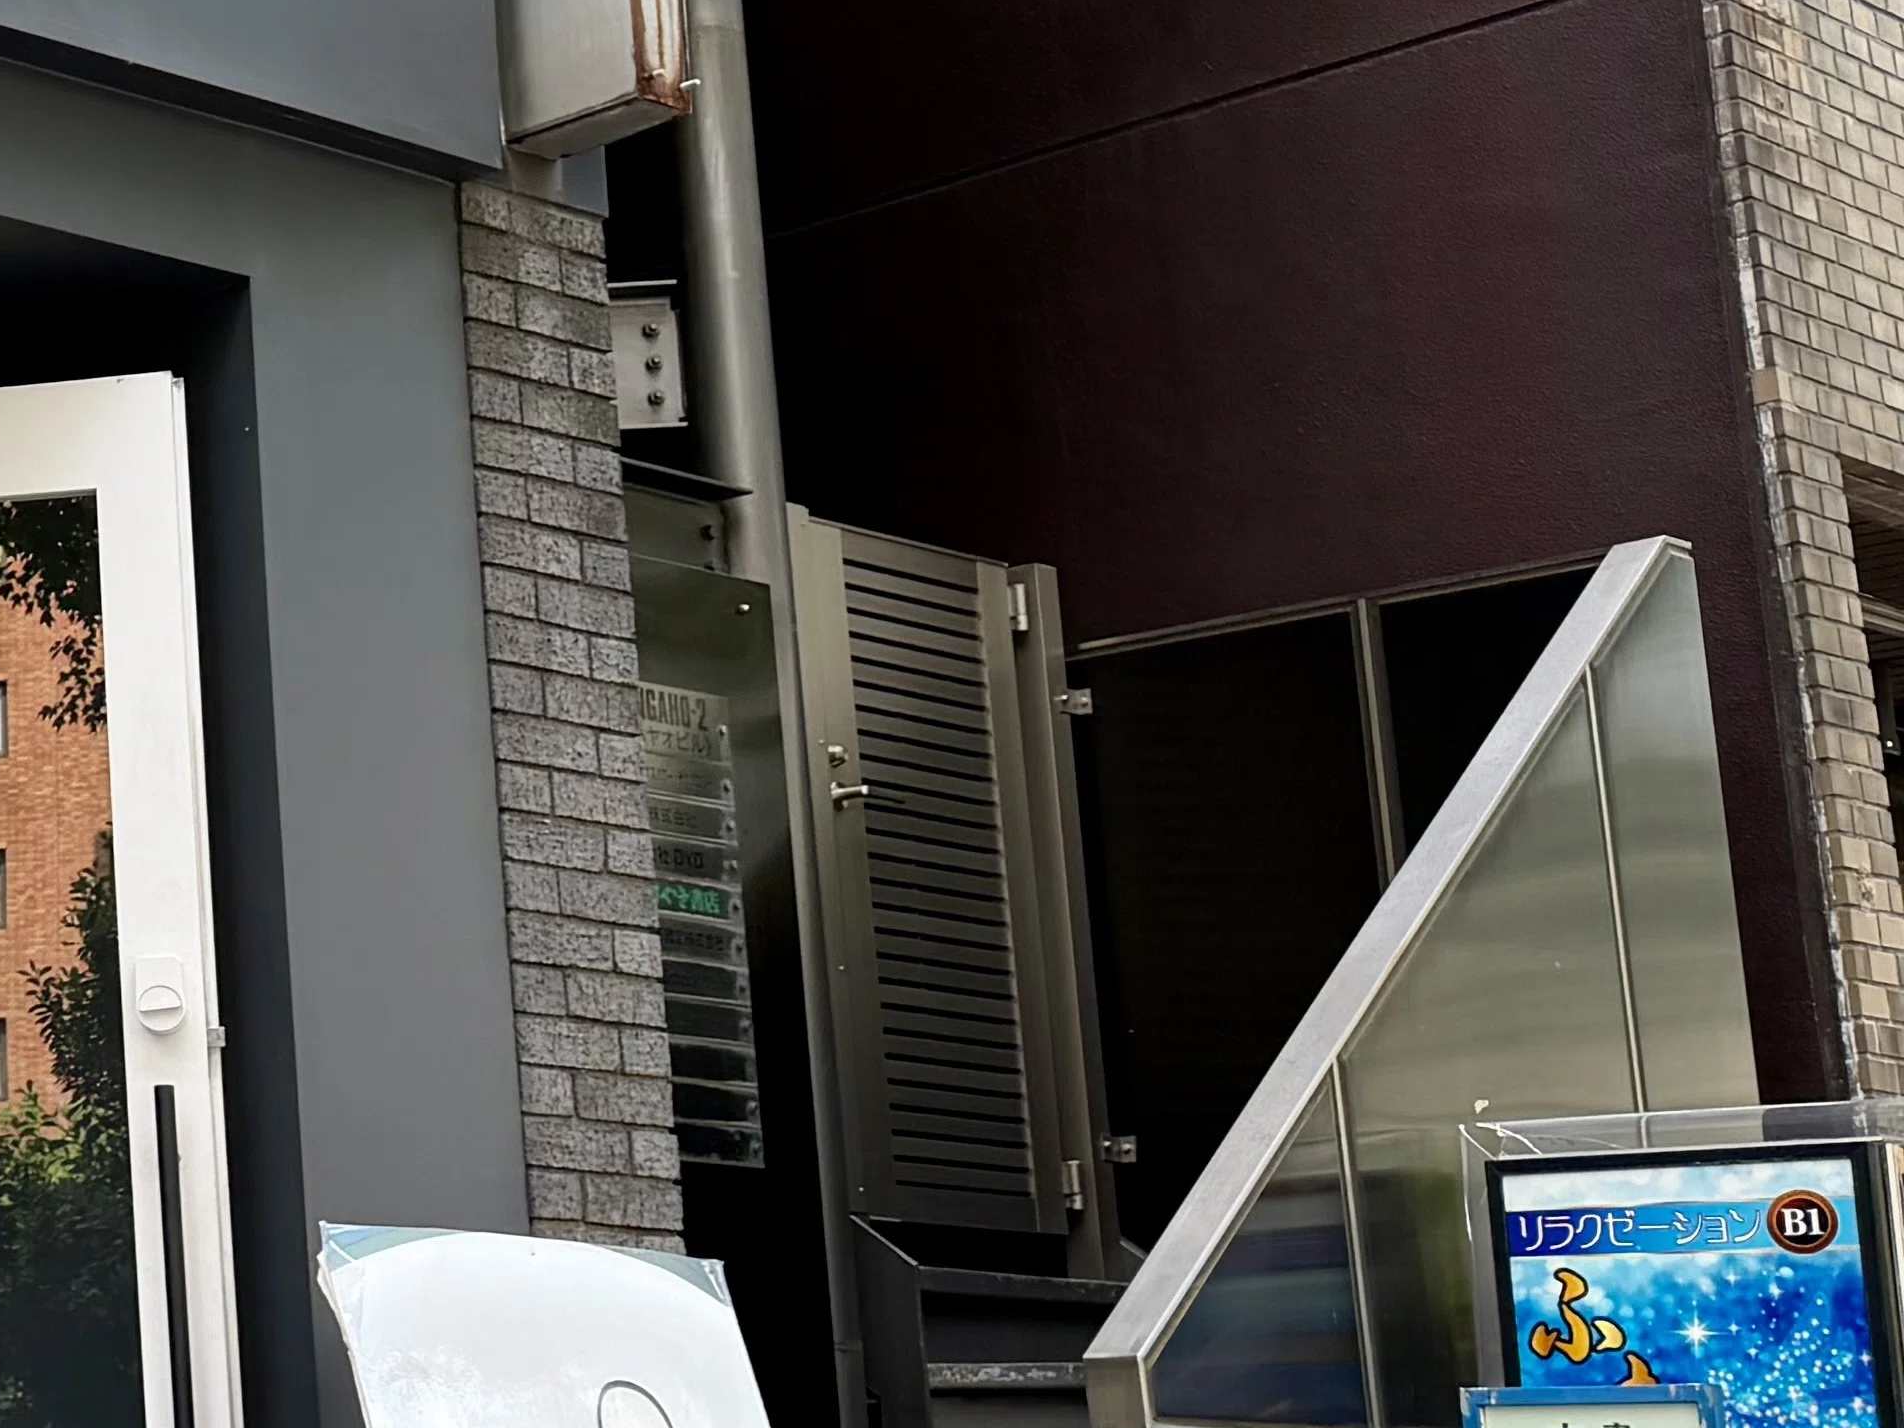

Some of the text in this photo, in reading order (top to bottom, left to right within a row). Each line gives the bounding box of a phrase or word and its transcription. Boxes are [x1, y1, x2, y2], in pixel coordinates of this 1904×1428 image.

[1518, 1207, 1826, 1252] リラクゼーション B1
